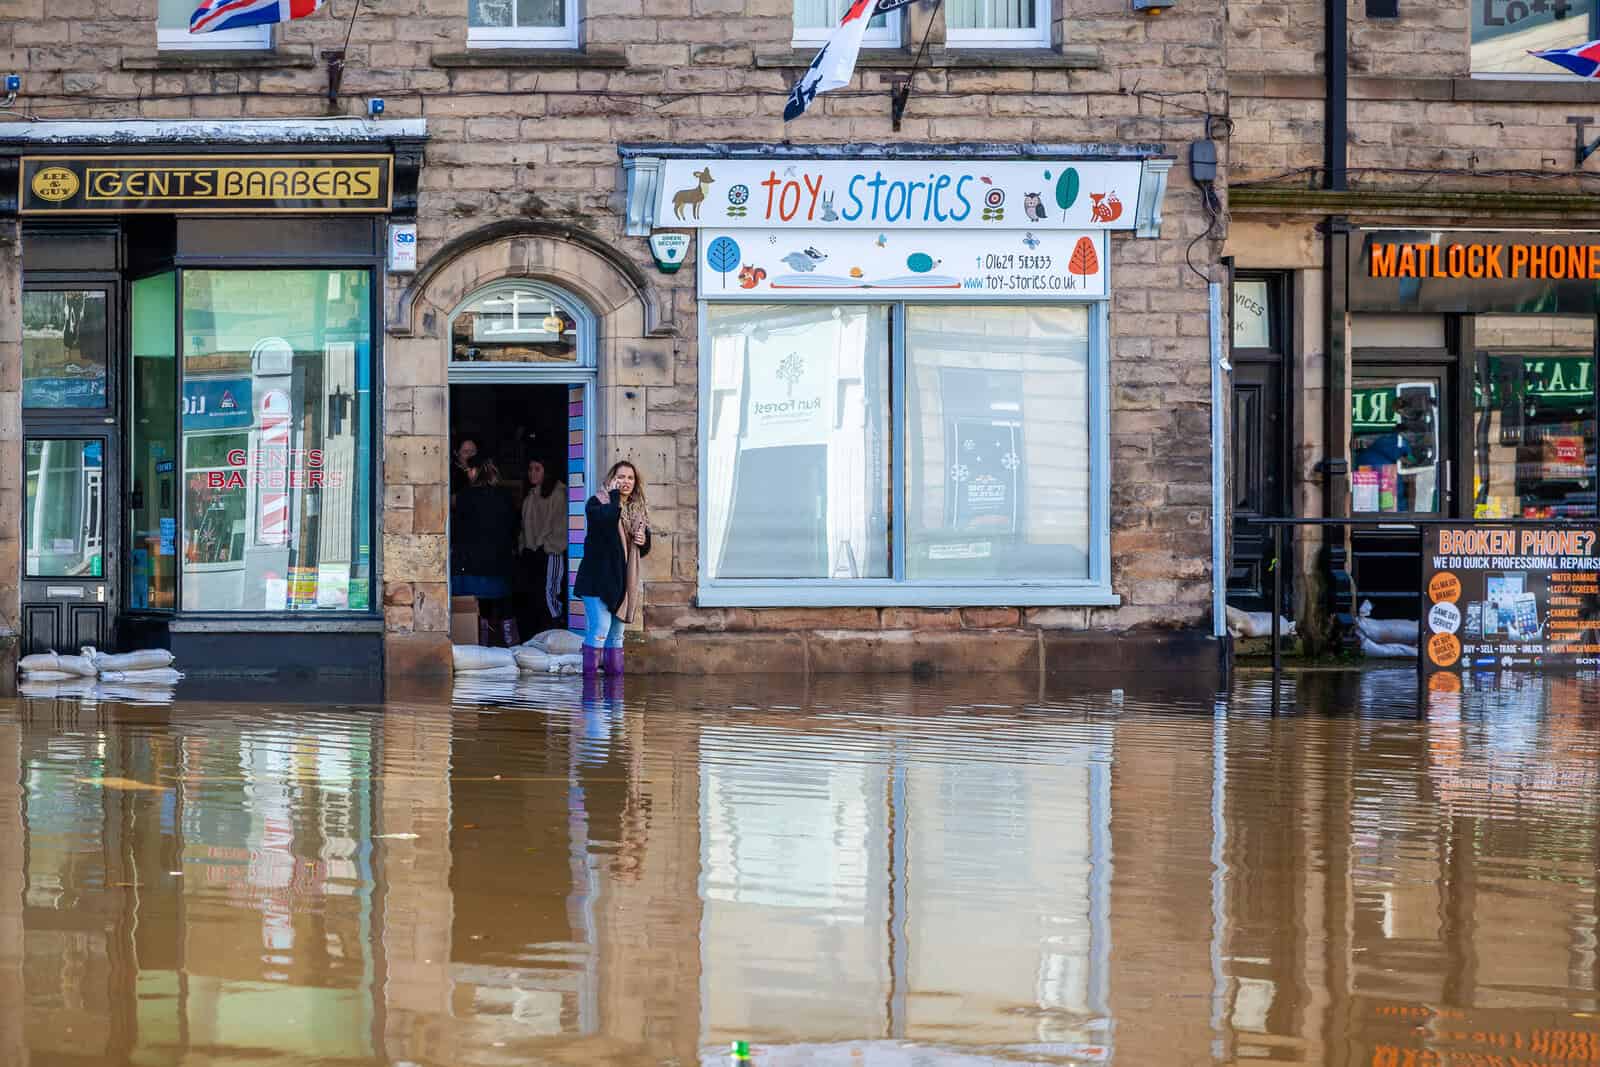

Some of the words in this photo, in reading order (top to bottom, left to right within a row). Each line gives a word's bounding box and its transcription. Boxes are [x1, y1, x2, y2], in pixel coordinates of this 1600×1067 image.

[39, 187, 70, 196] GUY
[94, 172, 213, 196] GENTS
[224, 170, 372, 196] BARBERS
[985, 253, 1014, 270] 01629
[1370, 242, 1503, 279] MATLOCK
[227, 449, 324, 467] GENTS
[207, 470, 344, 489] BARBERS
[1439, 529, 1516, 555] BROKEN
[1521, 530, 1596, 556] PHONE?
[1433, 557, 1447, 569] WE
[1449, 557, 1462, 569] DO
[1463, 557, 1490, 570] QUICK
[1492, 557, 1558, 570] PROFESSIONAL
[1463, 645, 1475, 653] BUY
[1480, 645, 1494, 653] SELL
[1499, 645, 1517, 653] TRADE
[1522, 645, 1544, 654] UNLOCK
